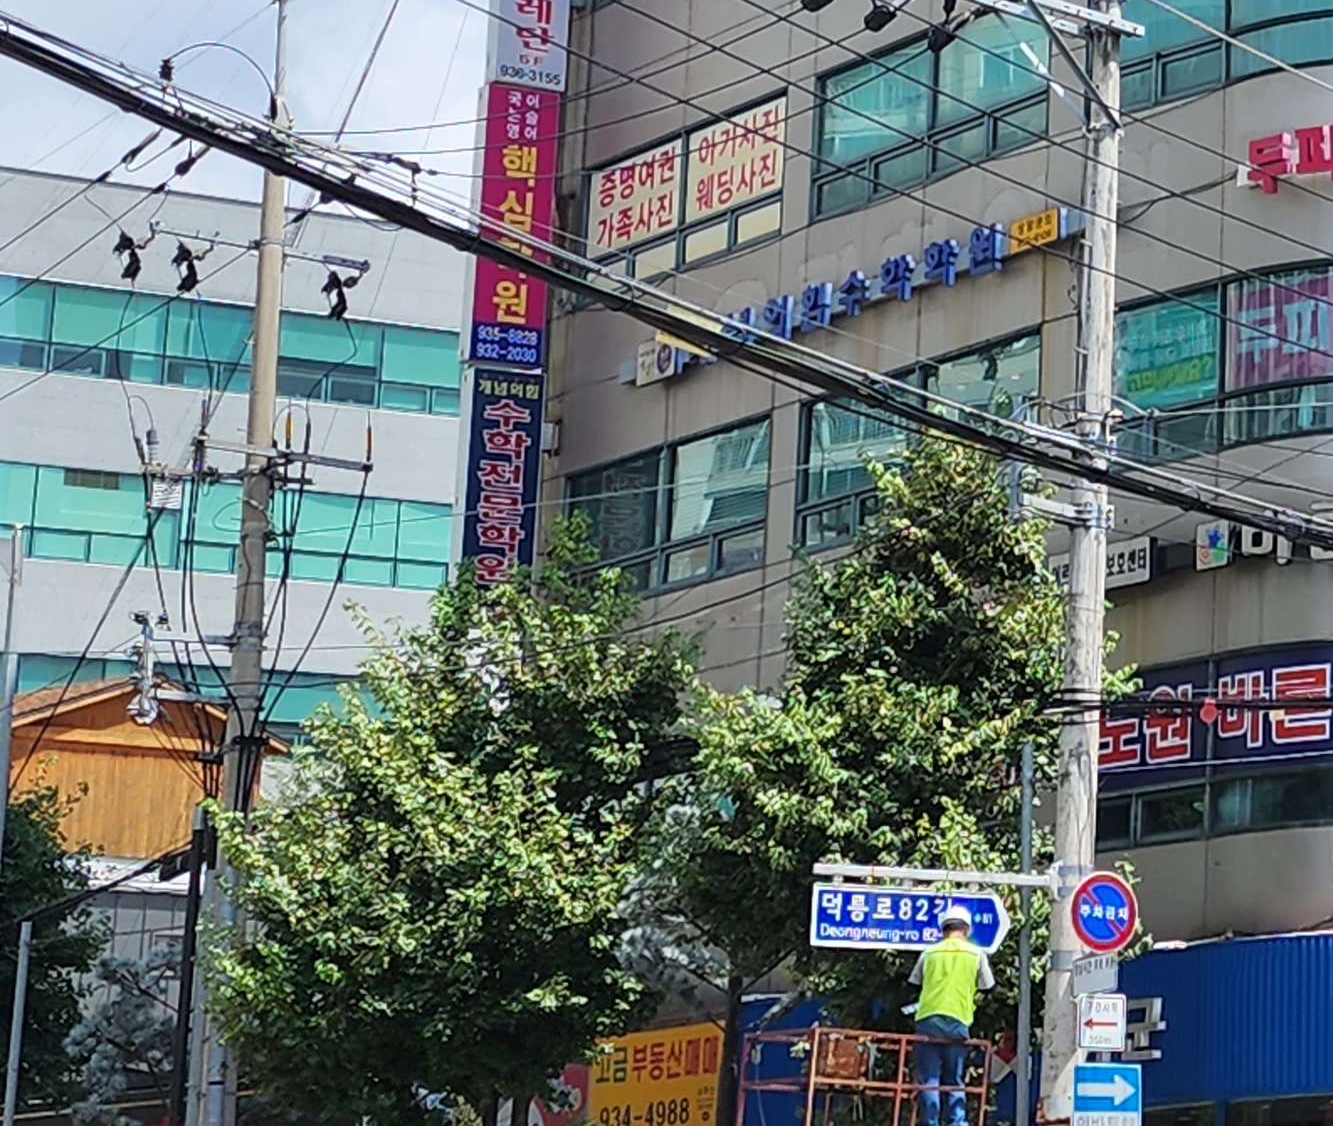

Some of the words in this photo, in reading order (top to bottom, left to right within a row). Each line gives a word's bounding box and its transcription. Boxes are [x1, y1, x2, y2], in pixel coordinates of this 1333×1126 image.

[597, 146, 677, 209] 증명여권
[699, 107, 780, 165] 아기사진
[596, 190, 675, 248] 가족사진
[696, 148, 778, 210] 웨딩사진
[1238, 296, 1330, 364] 두피
[1218, 663, 1332, 750] 바른
[820, 924, 919, 943] Deongneung-ro
[1080, 903, 1129, 922] 주차금지
[600, 1098, 690, 1126] 934-4988
